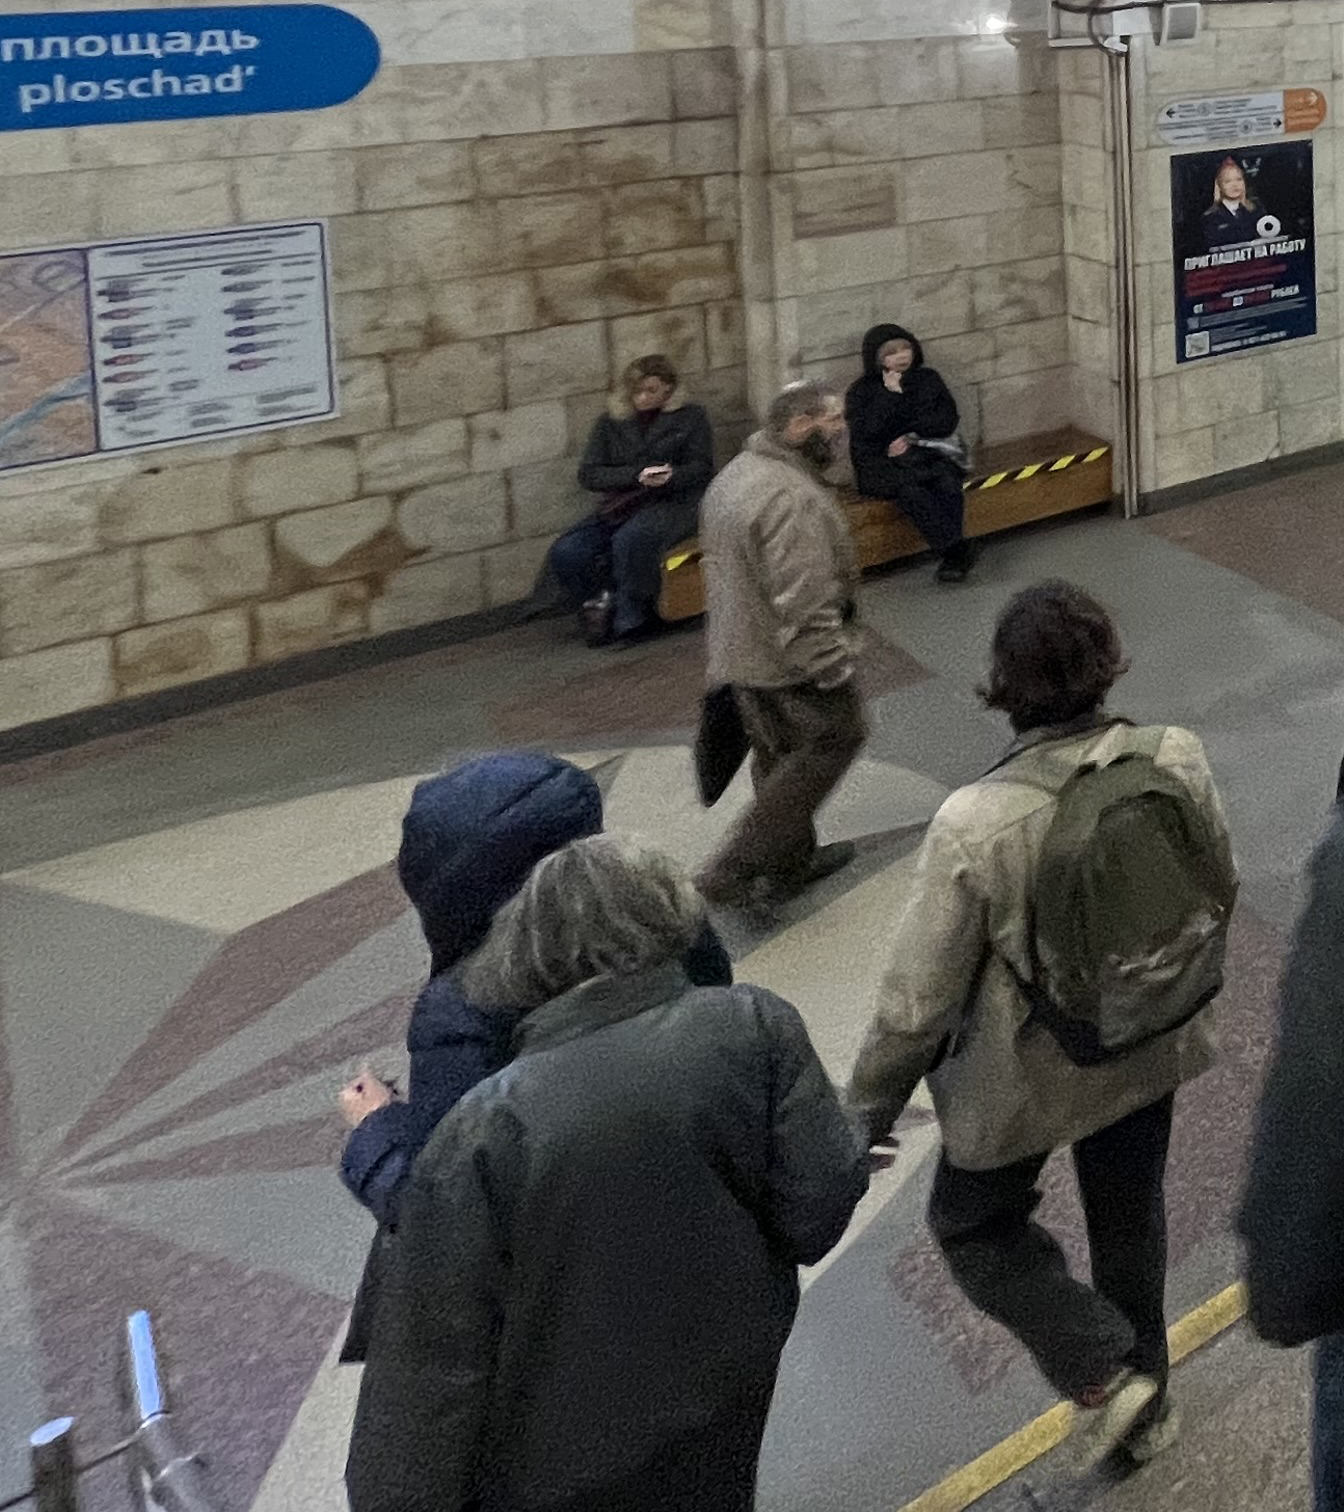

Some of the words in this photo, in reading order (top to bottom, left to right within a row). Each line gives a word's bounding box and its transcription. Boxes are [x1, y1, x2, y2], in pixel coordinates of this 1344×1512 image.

[0, 29, 260, 62] площадь
[18, 63, 256, 113] ploschad'
[1184, 247, 1253, 271] ПРИГЛАШАЕТ
[1269, 238, 1307, 256] РАБОТУ
